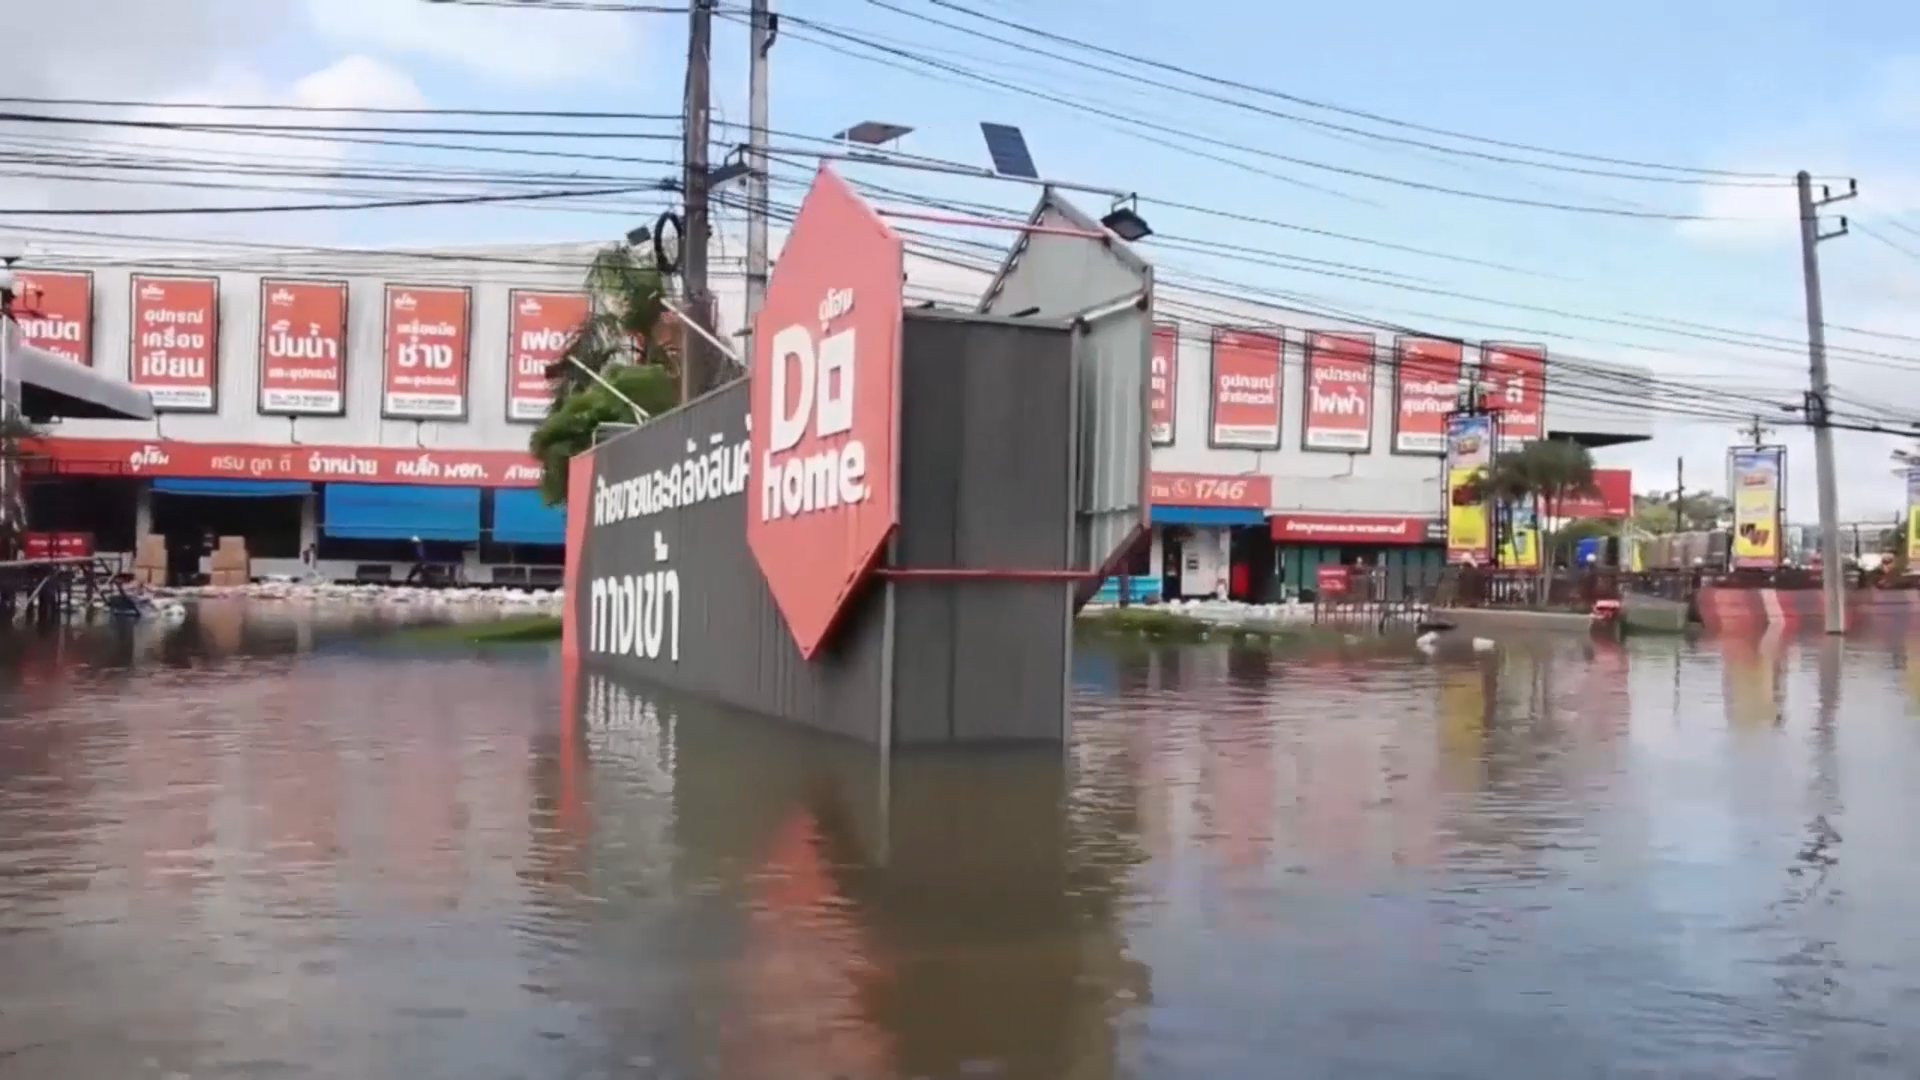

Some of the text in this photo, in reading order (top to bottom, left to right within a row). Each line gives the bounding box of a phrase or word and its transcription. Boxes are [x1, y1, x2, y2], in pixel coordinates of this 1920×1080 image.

[143, 308, 205, 327] อุปกรณ์
[142, 325, 205, 348] เครื่อง
[141, 349, 205, 378] เขียน
[398, 335, 453, 369] ช่าง
[1313, 365, 1368, 385] อุปกรณ์
[1309, 385, 1365, 415] ไฟฟ้า
[129, 444, 170, 472] ดูโฮม
[210, 455, 245, 472] ครบ
[307, 451, 379, 475] จำหน่าย
[1194, 480, 1249, 500] 1746
[590, 530, 680, 662] ทางเข้า
